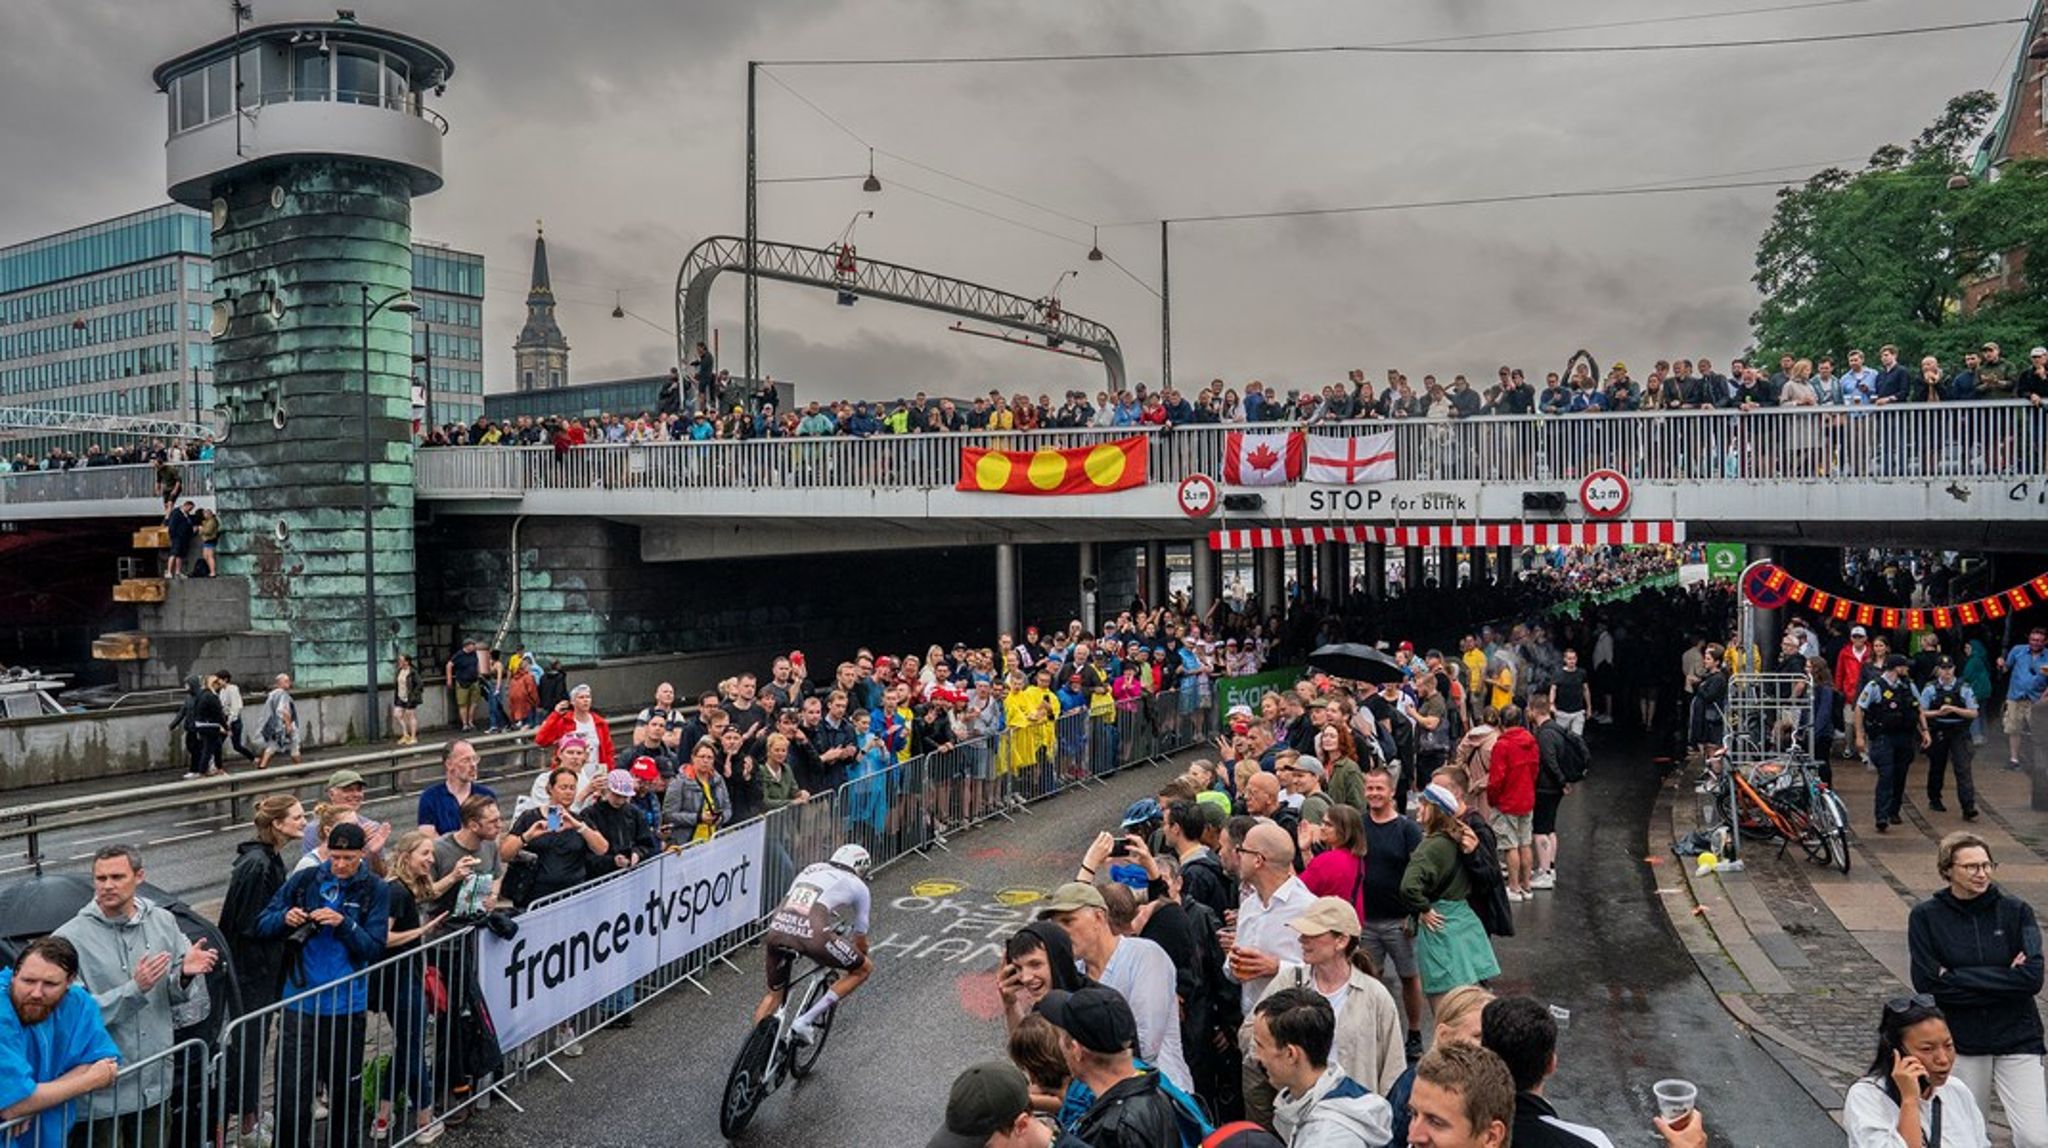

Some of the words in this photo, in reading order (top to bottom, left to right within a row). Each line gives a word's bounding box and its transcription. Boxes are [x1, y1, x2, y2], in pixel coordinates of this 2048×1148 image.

[1310, 489, 1382, 510] STOP
[1391, 496, 1416, 510] for
[1423, 495, 1466, 510] blink
[1607, 490, 1620, 498] m
[1227, 686, 1279, 708] ŠKO
